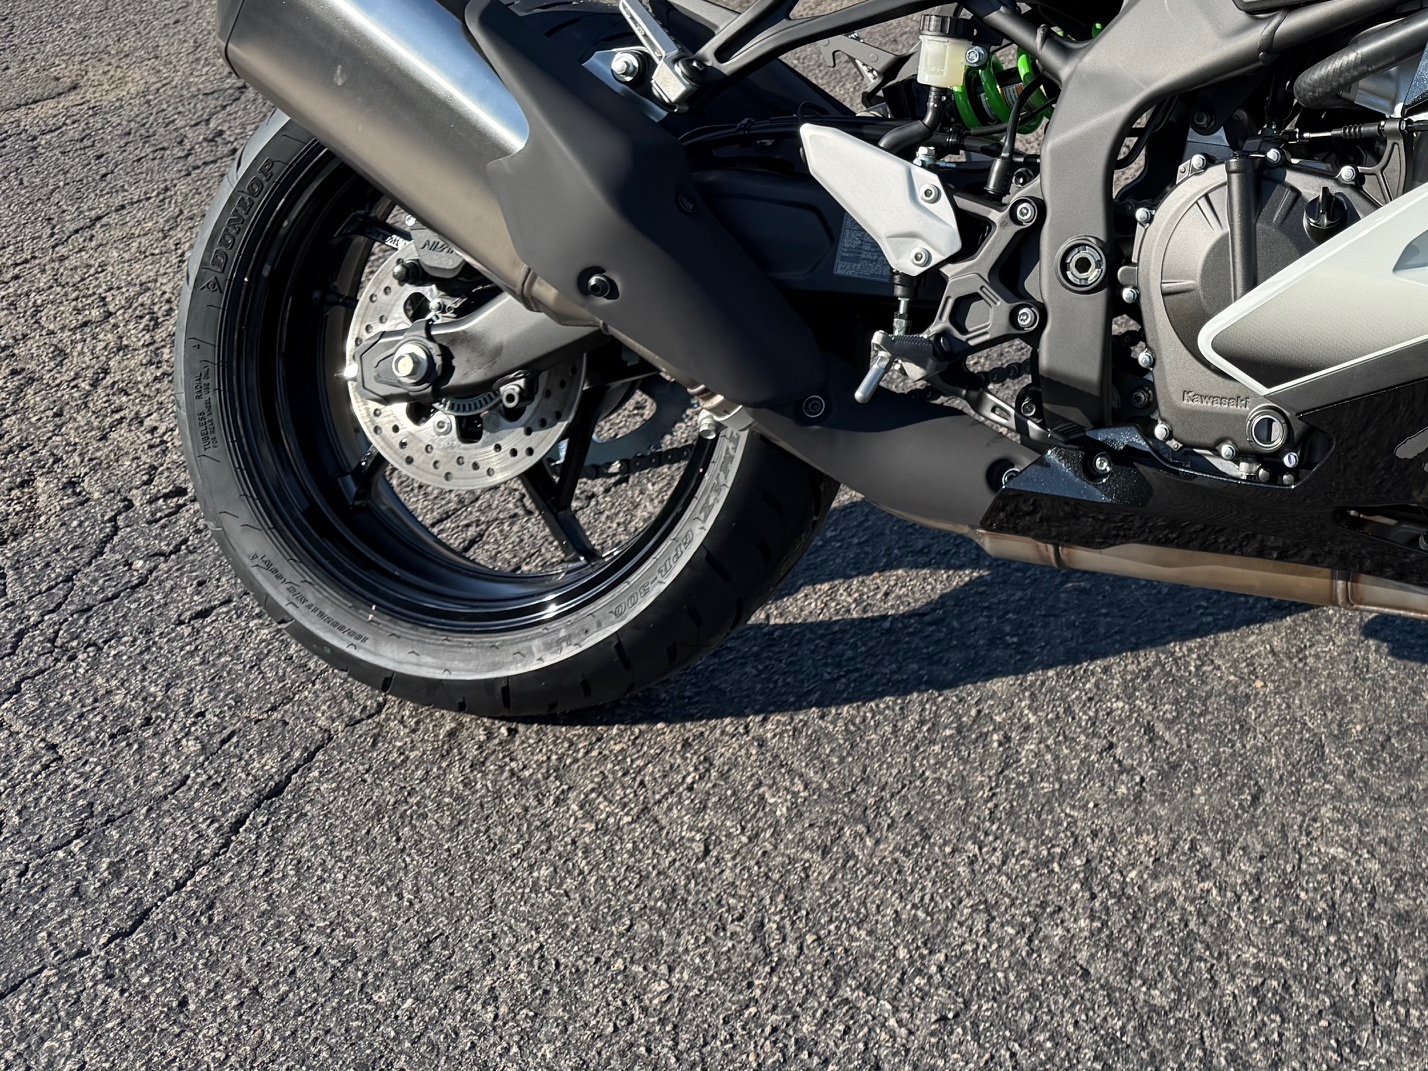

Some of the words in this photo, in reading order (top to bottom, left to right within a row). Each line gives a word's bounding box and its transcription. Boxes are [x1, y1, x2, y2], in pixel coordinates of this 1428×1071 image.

[210, 157, 275, 274] DUNLOP
[194, 372, 203, 400] RADIAL
[1182, 390, 1250, 410] Kawasaki
[197, 411, 211, 451] TUBELESS
